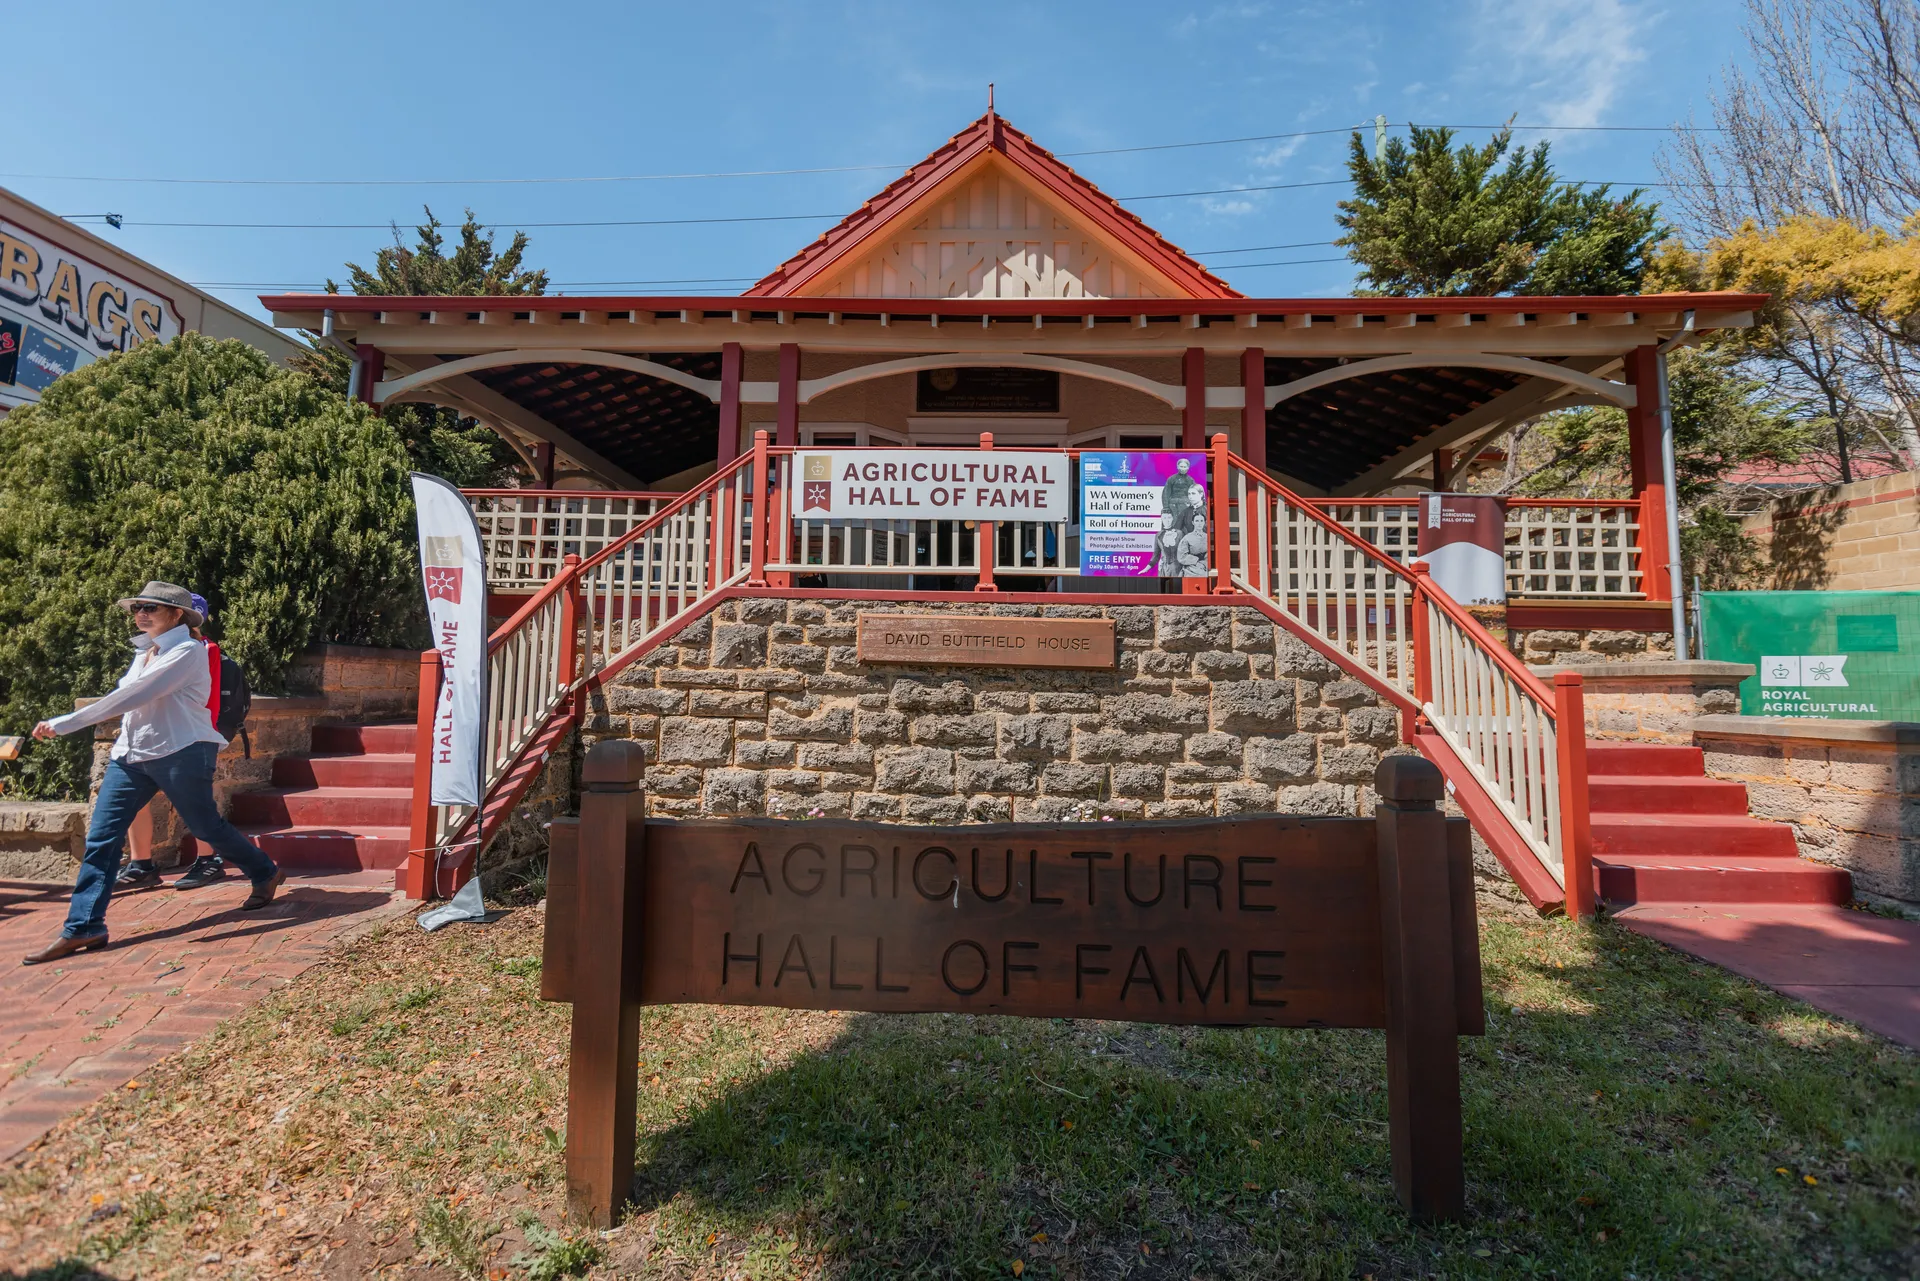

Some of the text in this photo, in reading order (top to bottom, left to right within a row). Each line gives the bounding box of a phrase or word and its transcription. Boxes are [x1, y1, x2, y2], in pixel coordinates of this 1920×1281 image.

[842, 462, 1056, 485] AGRICULTURAL
[848, 487, 1048, 509] HALL OF FAME
[1090, 490, 1154, 500] WA Women's
[1090, 501, 1151, 511] Hall of Fame
[1090, 519, 1154, 528] Roll of Honour
[1089, 555, 1141, 564] FREE ENTRY
[441, 620, 458, 669] FAME
[885, 633, 1090, 650] DAVID BUTTFIELD HOUSE
[1761, 690, 1811, 700] ROYAL
[1762, 702, 1878, 713] AGRICULTURAL
[439, 709, 453, 764] HALL
[730, 841, 1277, 911] AGRICULTURE
[722, 932, 1288, 1007] HALL OF FAME
